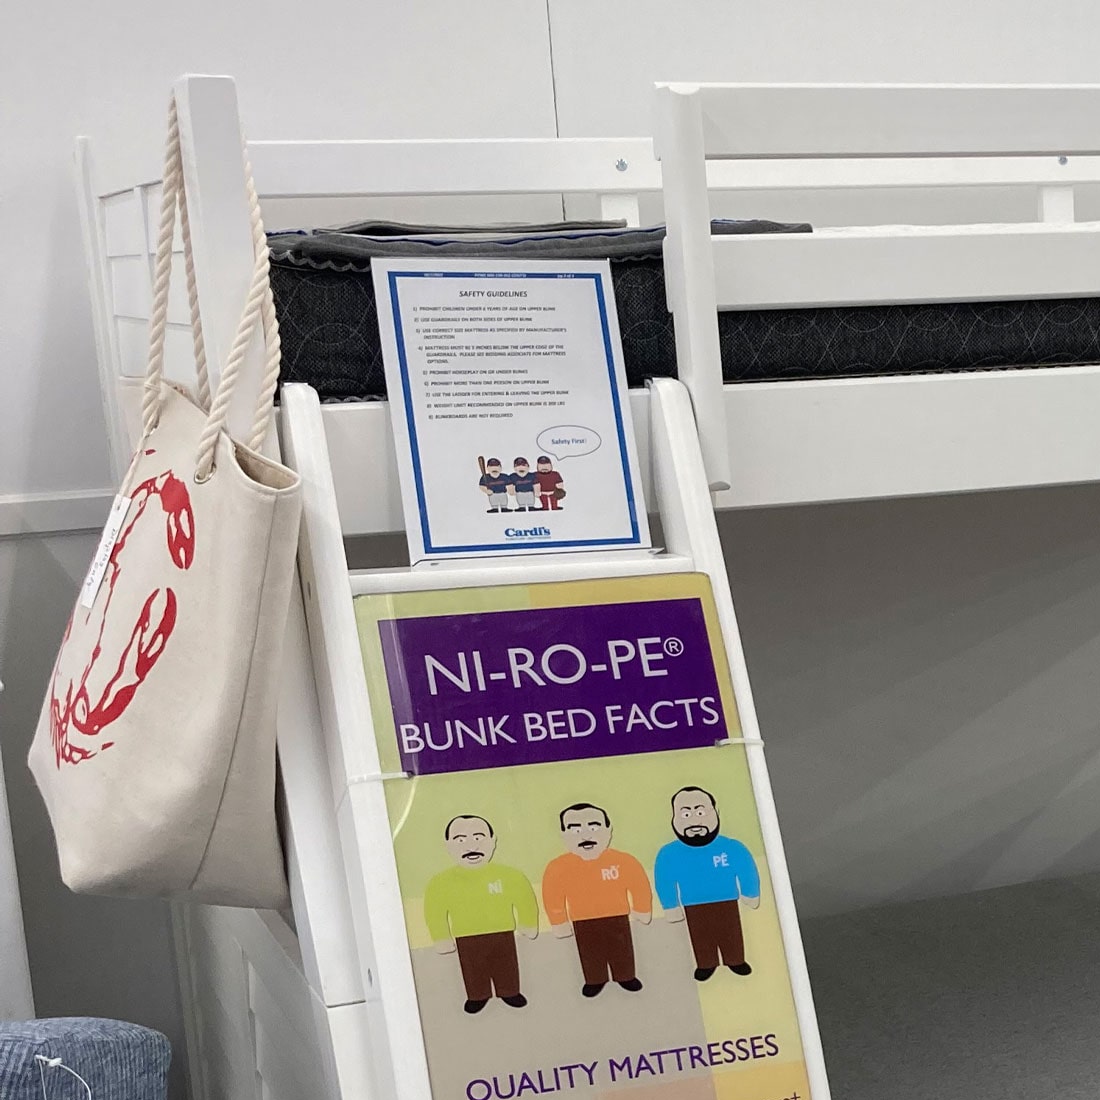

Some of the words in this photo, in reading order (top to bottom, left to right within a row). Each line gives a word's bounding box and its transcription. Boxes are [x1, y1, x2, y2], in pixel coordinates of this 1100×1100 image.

[458, 290, 485, 298] SAFETY
[486, 290, 528, 298] GUIDELINES
[504, 526, 551, 537] Cardi's
[400, 715, 517, 754] BUNK
[523, 708, 597, 742] BED
[605, 696, 720, 735] FACTS
[608, 1033, 779, 1082] MATTRESSES
